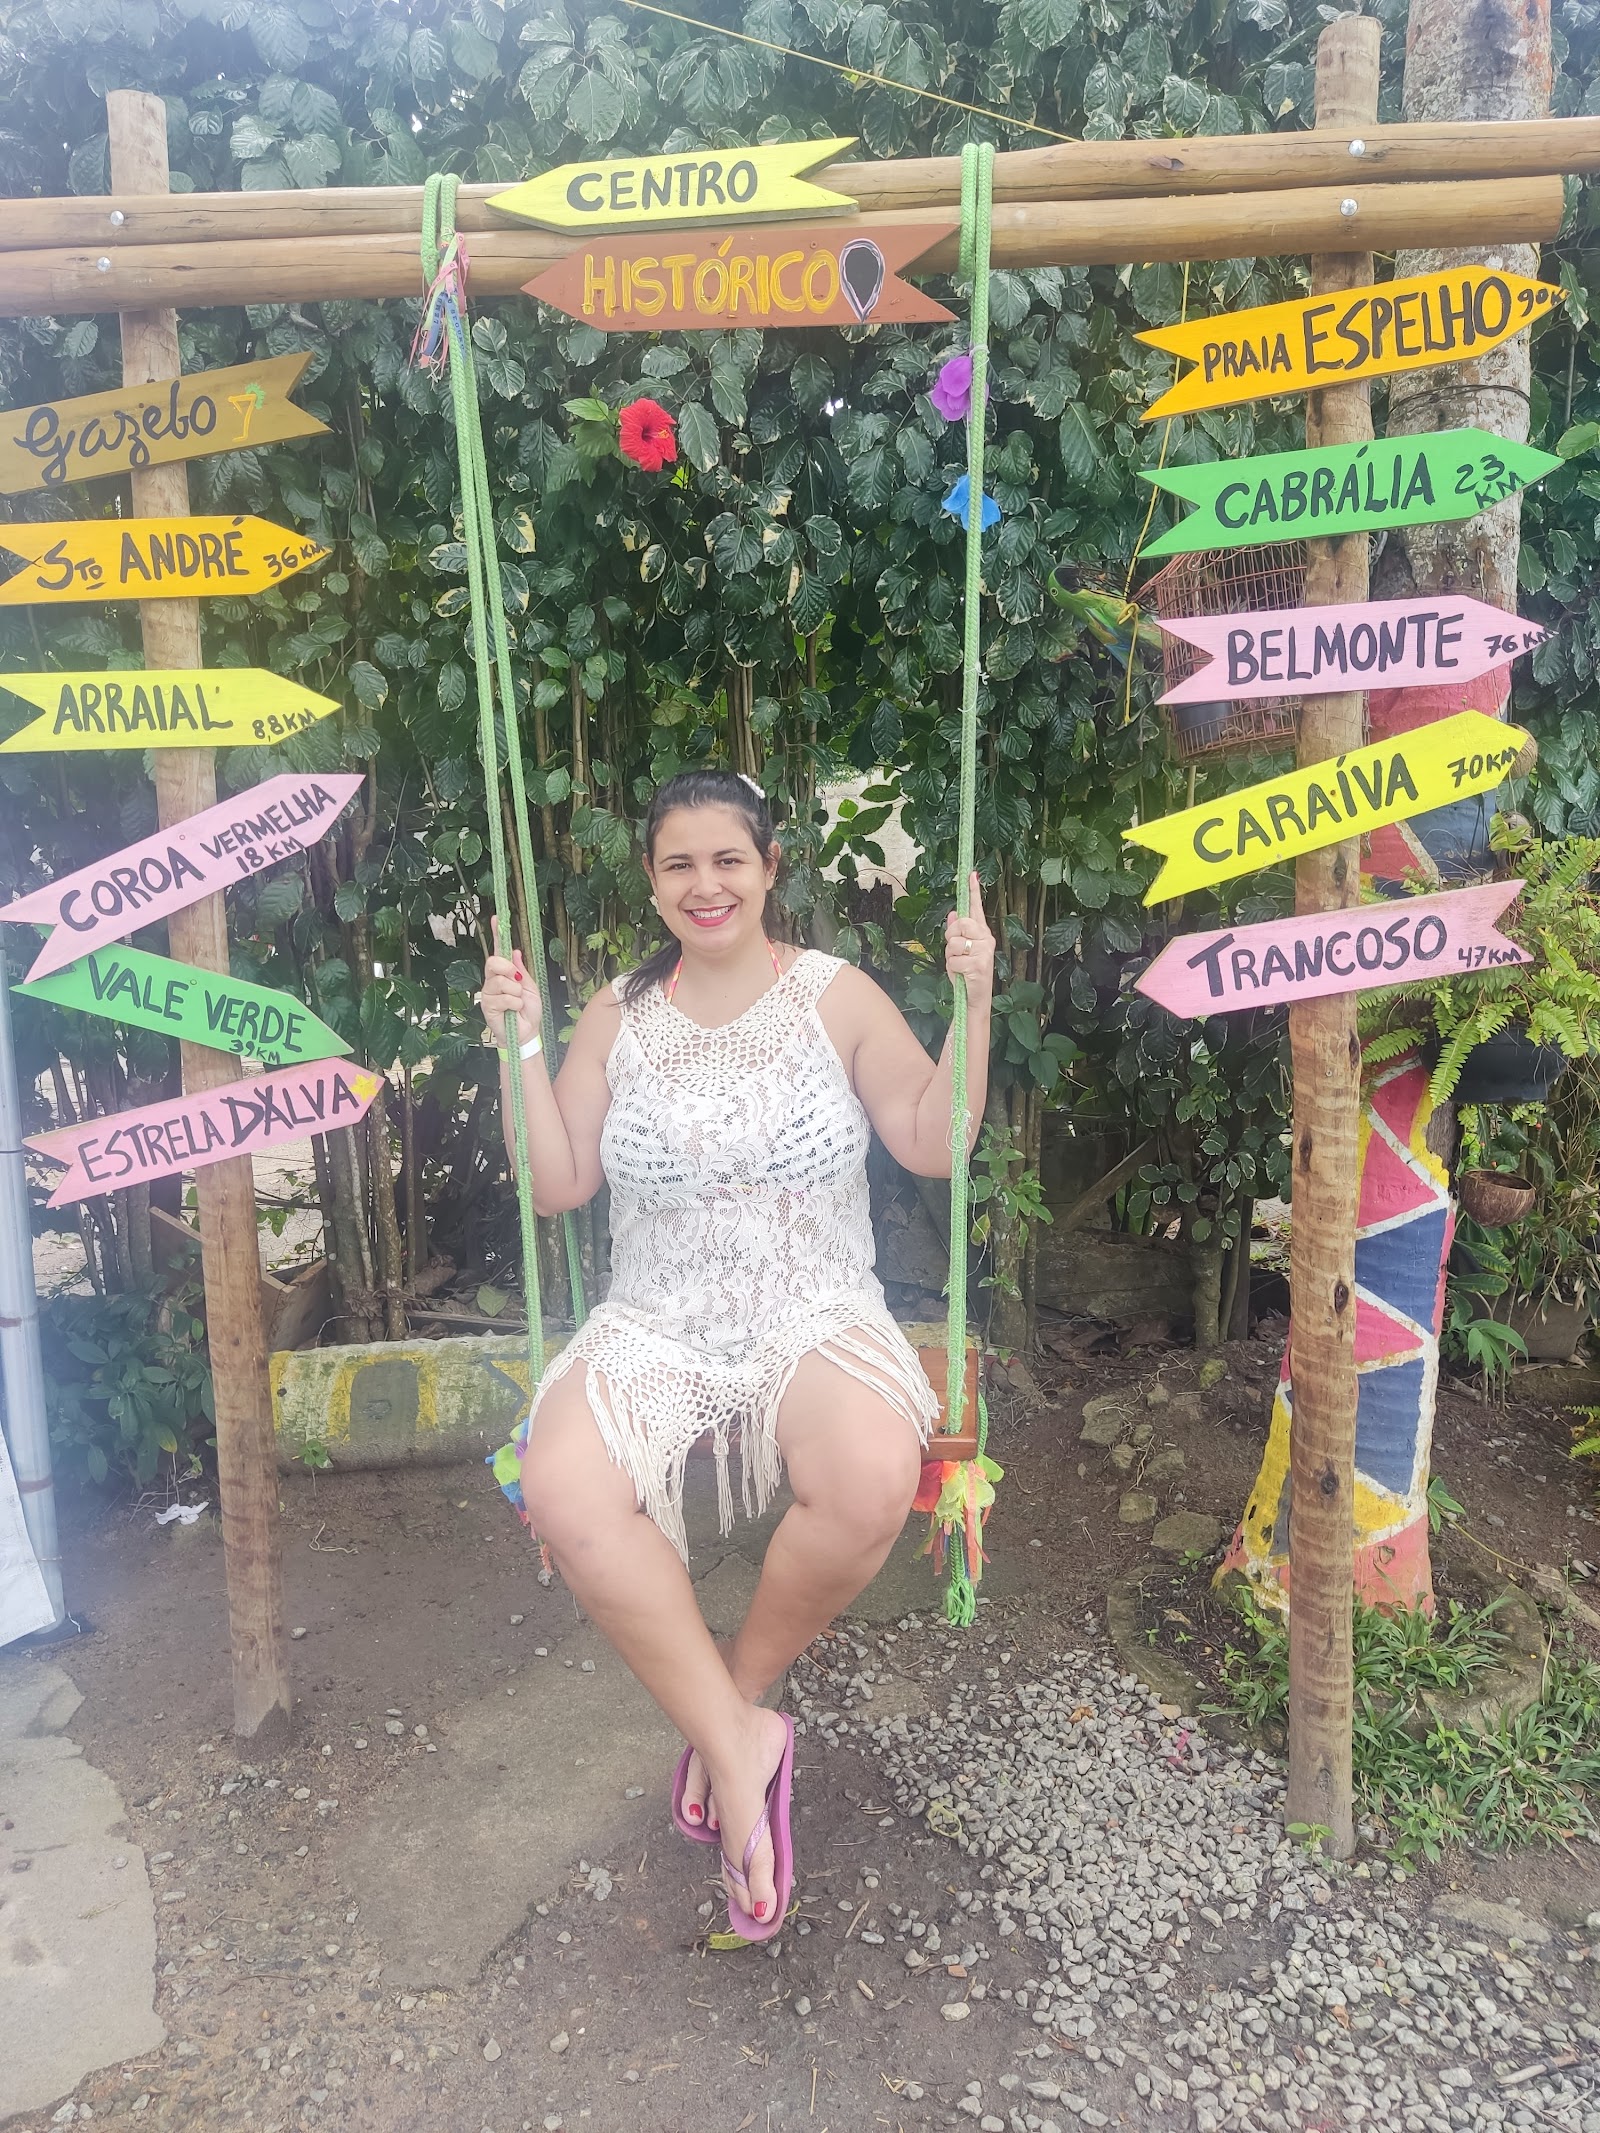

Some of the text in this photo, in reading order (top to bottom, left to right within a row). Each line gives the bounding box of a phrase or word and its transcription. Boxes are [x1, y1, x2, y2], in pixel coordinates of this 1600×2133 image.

[566, 160, 758, 212] CENTRO
[581, 235, 840, 317] HISTÓRICO
[1203, 333, 1291, 383] PRAIA
[1302, 276, 1511, 374] ESPELHO
[1214, 445, 1505, 529] CABRÁLIA 23
[1474, 470, 1527, 510] KM
[120, 516, 250, 583] ANDRÉ
[1227, 613, 1464, 685] BELMONTE
[53, 683, 233, 735] ARRAIAL
[1193, 753, 1419, 863] CARAÍVA
[59, 783, 337, 932] COROA VERMELHA
[1187, 915, 1448, 997] TRANCOSO
[88, 954, 306, 1052] VALE VERDE
[77, 1111, 226, 1183] ESTRELA
